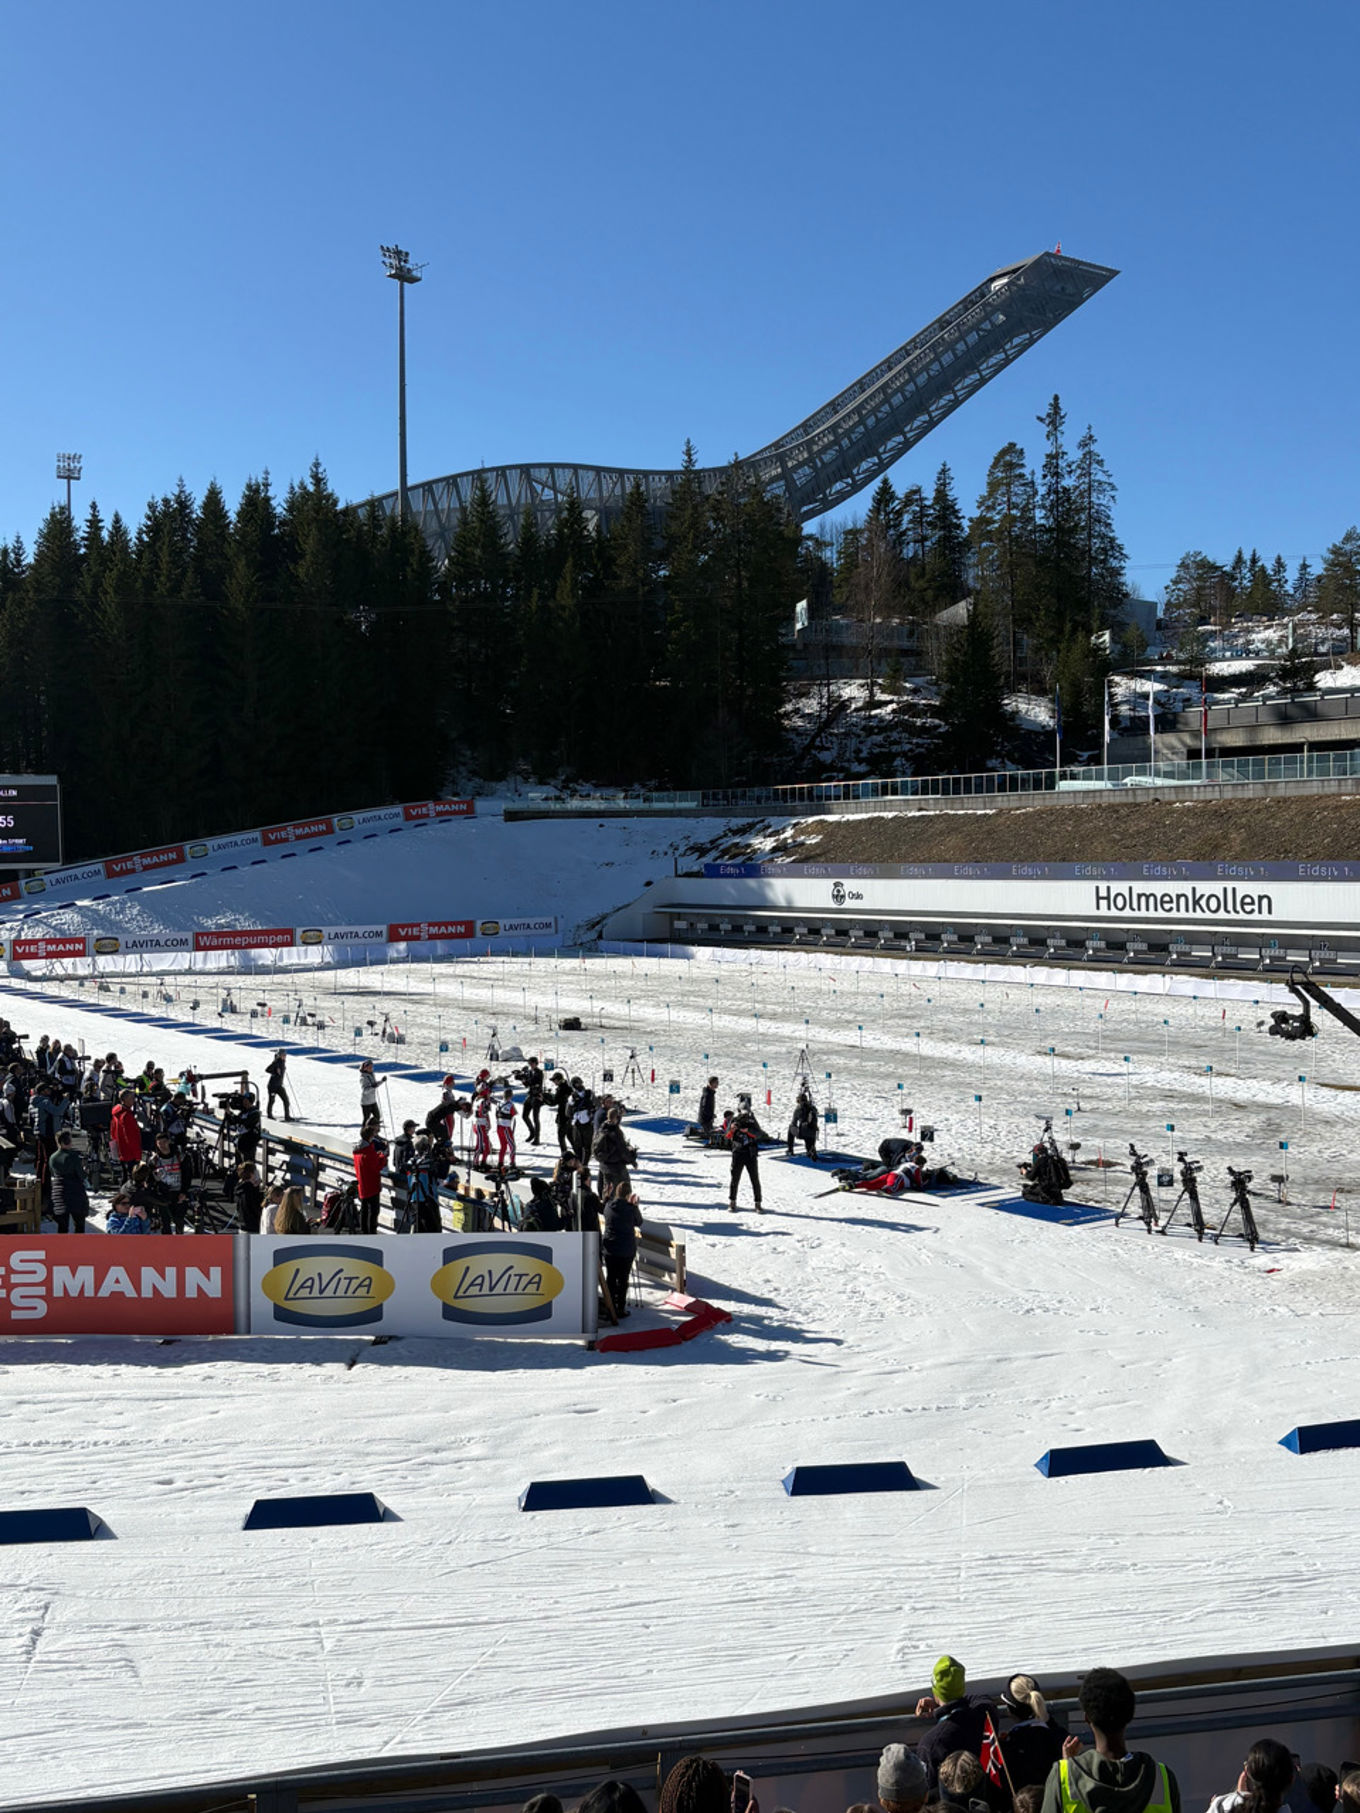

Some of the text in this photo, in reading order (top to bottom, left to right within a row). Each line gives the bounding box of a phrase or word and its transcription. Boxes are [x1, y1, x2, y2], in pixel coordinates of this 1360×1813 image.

[410, 803, 468, 817] VIESSMANN
[358, 811, 402, 825] LAVITA.COM
[268, 824, 326, 842] VIESSMANN
[212, 836, 258, 852] LAVITA.COM
[112, 852, 177, 872] VIESSMANN
[50, 869, 102, 887] LAVITA.COM
[848, 891, 864, 900] Oslo
[1095, 886, 1273, 915] Holmenkollen
[398, 923, 466, 941] VIESSMANN
[503, 921, 552, 932] LAVITA.COM
[198, 933, 291, 947] Wärmepumpen
[328, 930, 384, 940] LAVITA.COM
[15, 941, 84, 958] VIESSMANN
[125, 937, 189, 949] LAVITA.COM
[924, 1130, 931, 1141] 2
[0, 1250, 222, 1320] SSMANN
